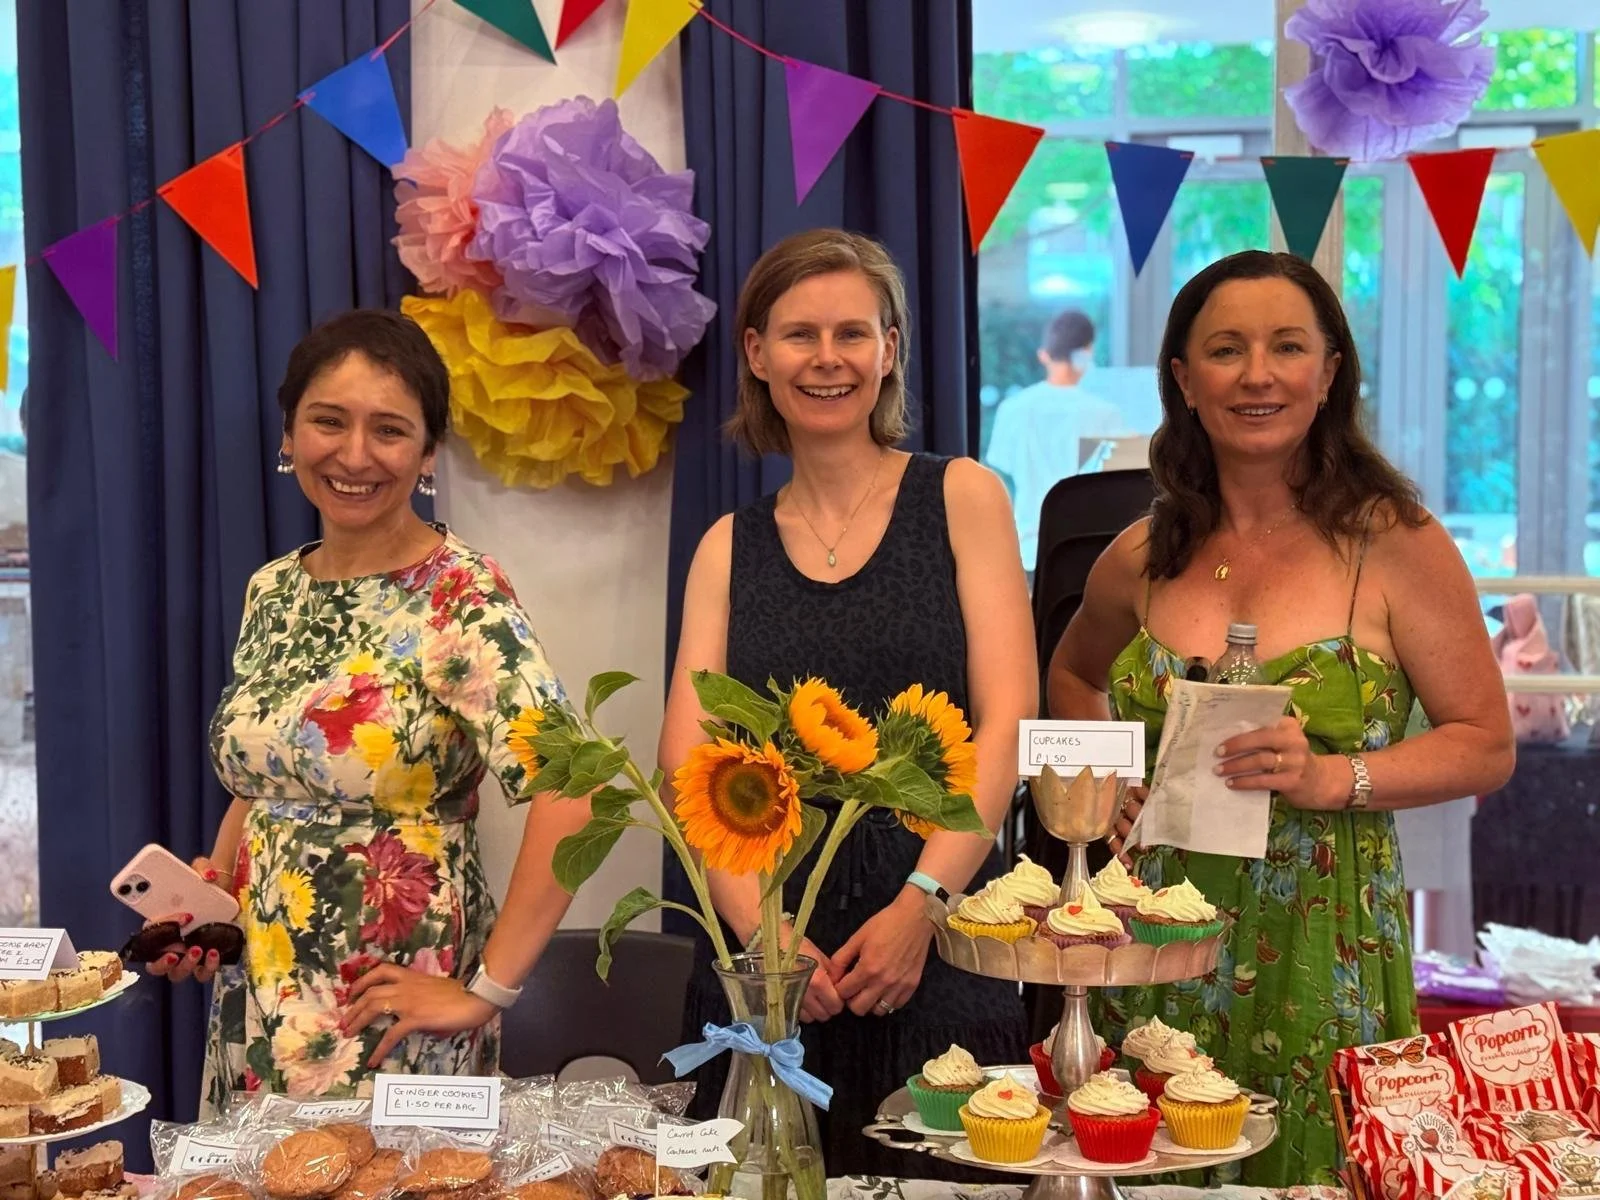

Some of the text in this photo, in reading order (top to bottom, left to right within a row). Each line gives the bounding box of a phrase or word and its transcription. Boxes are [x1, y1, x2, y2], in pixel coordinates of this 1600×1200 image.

[1033, 736, 1081, 747] CUPCAKES
[1474, 1024, 1541, 1053] Popcorn
[1375, 1072, 1443, 1093] Popcorn
[393, 1087, 485, 1099] GINGER COOKIES
[434, 1102, 451, 1110] PER
[455, 1103, 477, 1112] BAG
[666, 1128, 720, 1139] Carrot Cake
[666, 1146, 697, 1155] Contains
